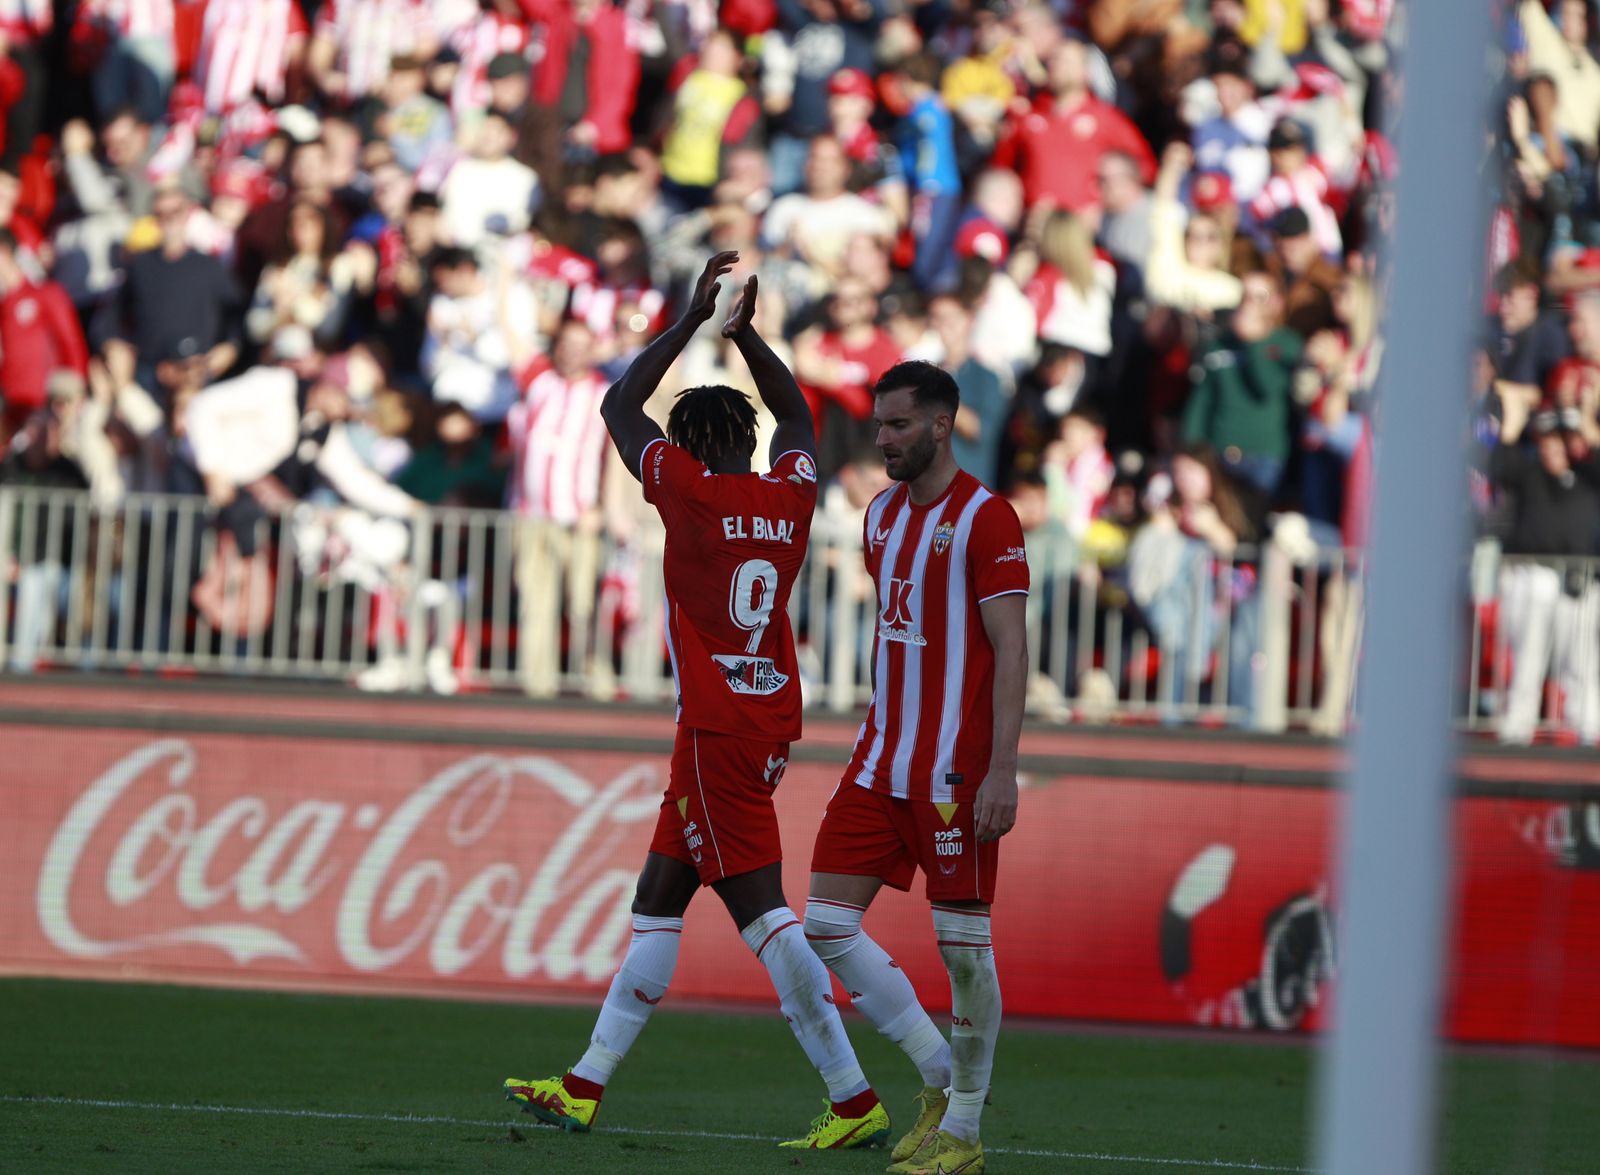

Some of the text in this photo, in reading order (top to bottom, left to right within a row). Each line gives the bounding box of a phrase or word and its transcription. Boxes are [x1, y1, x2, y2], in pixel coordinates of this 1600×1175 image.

[721, 515, 795, 545] EL BILAL
[727, 558, 779, 655] 9
[935, 842, 963, 856] KUDU
